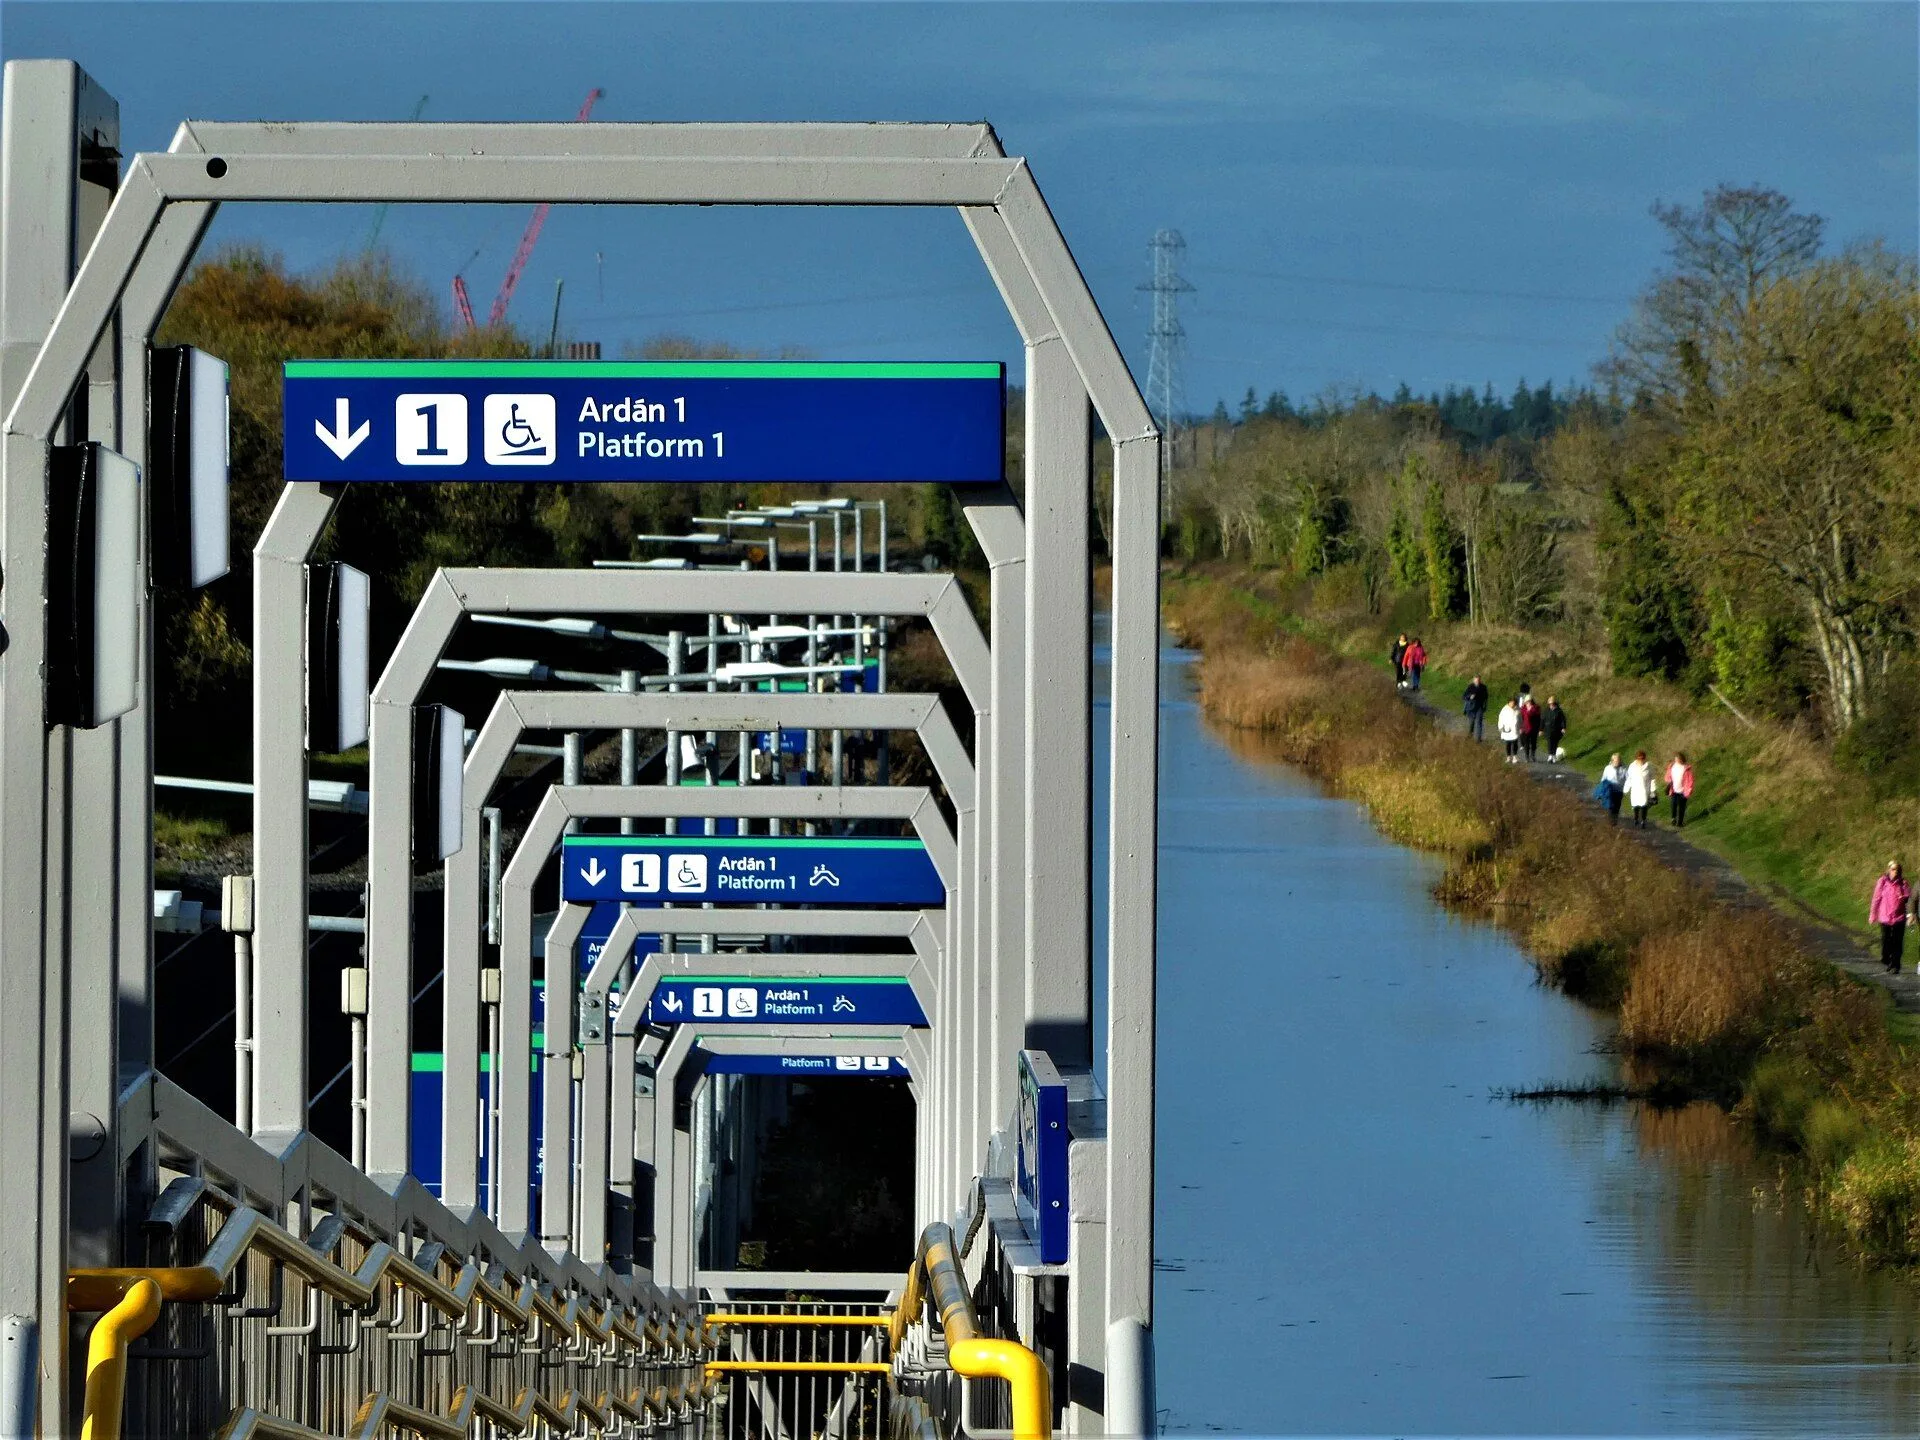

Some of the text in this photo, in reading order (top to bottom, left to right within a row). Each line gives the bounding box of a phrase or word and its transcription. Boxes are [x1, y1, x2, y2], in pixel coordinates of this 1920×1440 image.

[578, 396, 685, 423] Ardán 1
[415, 403, 448, 456] 1
[578, 431, 724, 458] Platform 1
[718, 855, 776, 871] Ardán 1
[632, 860, 649, 887] 1
[718, 874, 796, 890] Platform 1
[702, 992, 714, 1013] 1
[765, 989, 809, 1001] Ardán 1
[764, 1003, 823, 1014] Platform 1
[782, 1057, 824, 1068] Platform
[825, 1058, 830, 1067] 1
